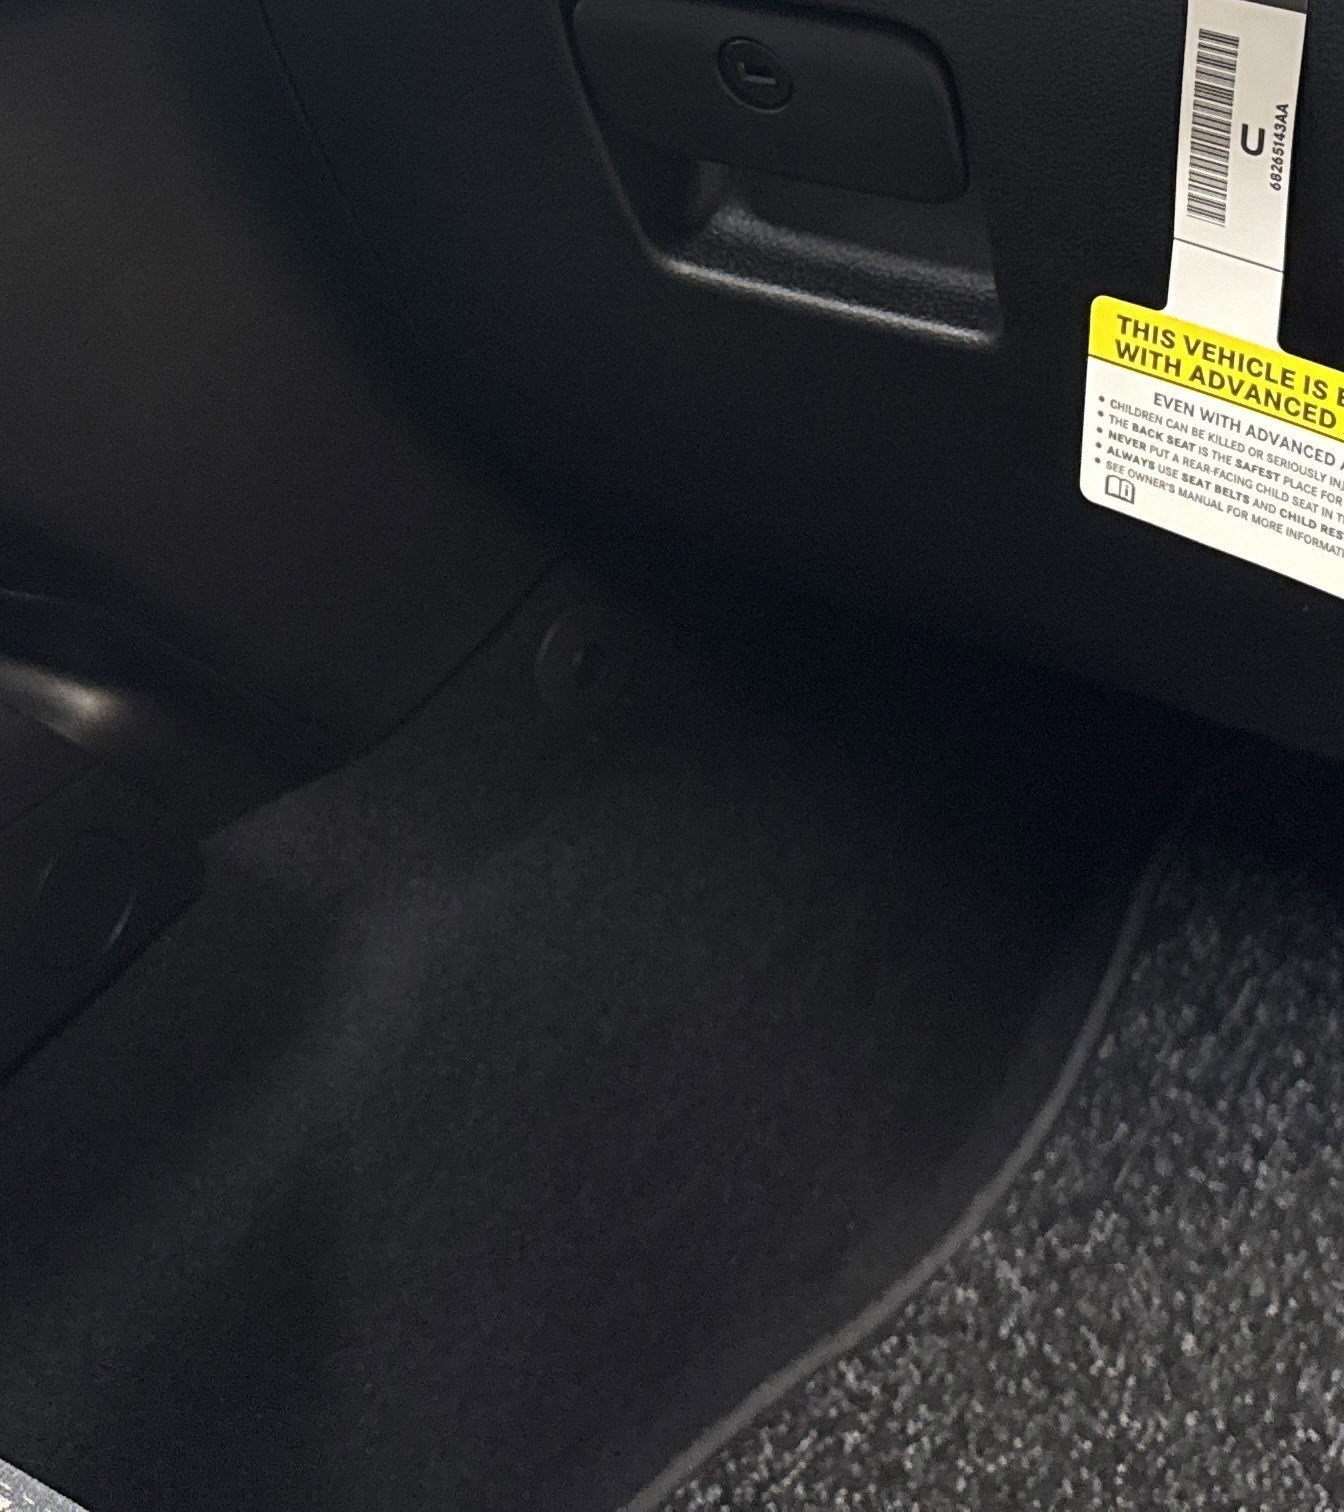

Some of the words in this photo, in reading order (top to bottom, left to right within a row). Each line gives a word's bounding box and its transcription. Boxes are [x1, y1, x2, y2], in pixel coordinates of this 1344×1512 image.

[1269, 103, 1290, 192] 68265143AA
[1114, 338, 1182, 378] WITH
[1187, 364, 1337, 429] ADVANCED
[1116, 313, 1176, 350] THIS
[1183, 334, 1297, 391] VEHICLE
[1303, 375, 1329, 401] IS
[1109, 413, 1129, 429] THE
[1132, 422, 1164, 442] BACK
[1166, 435, 1196, 452] SEAT
[1198, 446, 1208, 457] IS
[1212, 449, 1233, 466] THE
[1234, 458, 1281, 482] SAFEST
[1283, 475, 1318, 497] PLACE
[1320, 490, 1343, 507] FOR
[1110, 399, 1163, 425] CHILDREN
[1166, 418, 1189, 434] CAN
[1191, 426, 1205, 440] BE
[1208, 432, 1245, 453] KILLED
[1248, 446, 1264, 460] OR
[1266, 453, 1327, 483] SERIOUSLY
[1153, 392, 1195, 417] EVEN
[1199, 407, 1241, 434] WITH
[1245, 424, 1336, 467] ADVANCED
[1106, 445, 1155, 470] ALWAYS
[1158, 464, 1179, 479] USE
[1181, 472, 1212, 490] SEAT
[1214, 483, 1250, 505] BELTS
[1252, 498, 1276, 514] AND
[1279, 508, 1317, 529] CHILD
[1106, 460, 1125, 475] SEE
[1127, 468, 1175, 494] OWNER'S
[1178, 487, 1224, 512] MANUAL
[1226, 504, 1249, 521] FOR
[1251, 514, 1283, 534] MORE
[1108, 429, 1147, 452] NEVER
[1149, 444, 1170, 459] PUT
[1172, 453, 1179, 463] A
[1182, 456, 1253, 489] REAR-FACING
[1256, 482, 1289, 502] CHILD
[1292, 495, 1319, 513] SEAT
[1321, 506, 1333, 520] IN
